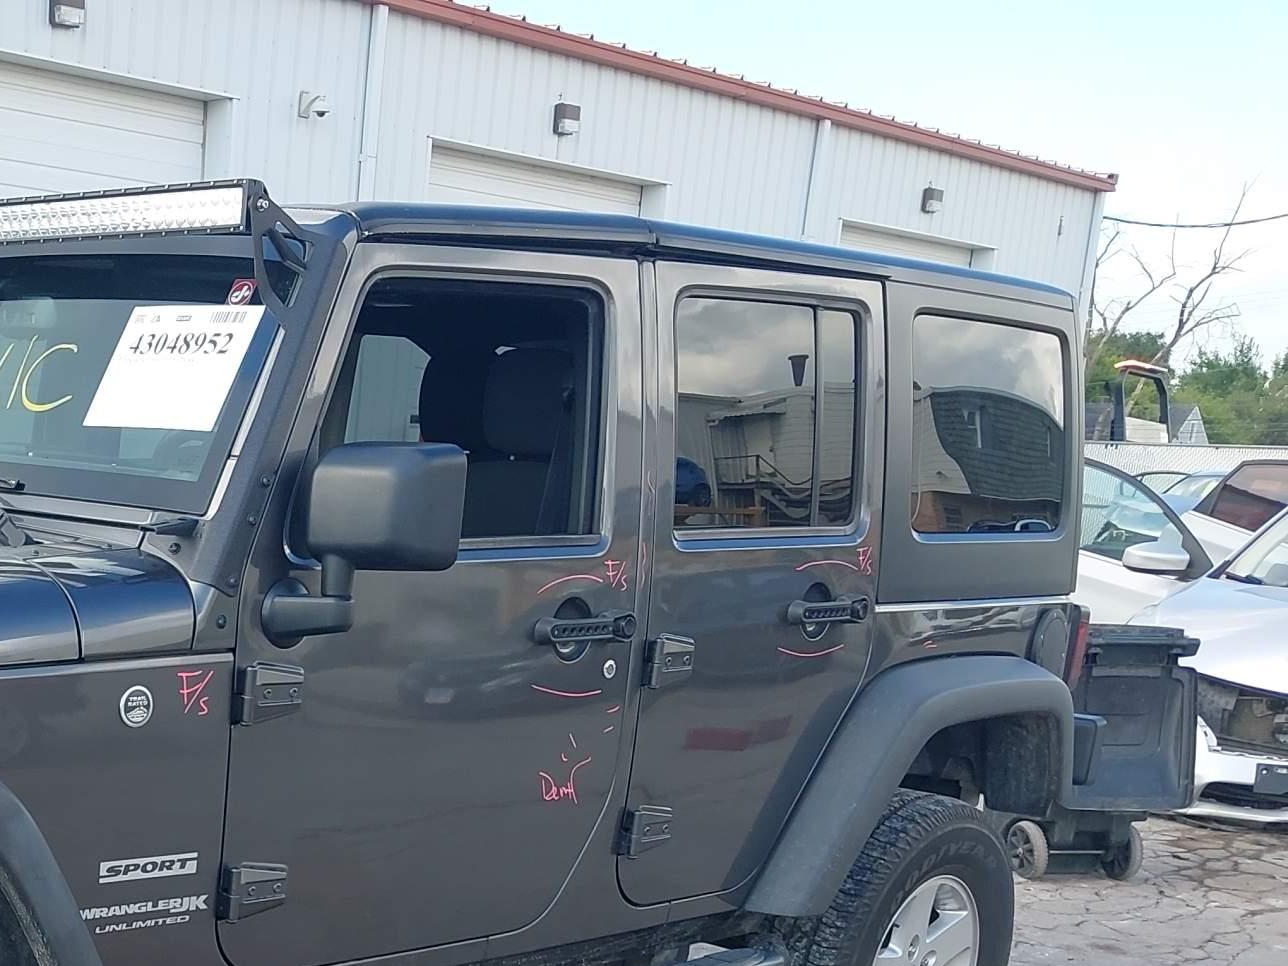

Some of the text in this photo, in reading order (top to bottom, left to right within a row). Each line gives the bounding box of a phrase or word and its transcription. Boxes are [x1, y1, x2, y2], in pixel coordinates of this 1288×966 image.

[129, 332, 234, 355] 43048952
[104, 859, 193, 878] SPORT
[95, 914, 191, 934] UNLIMITED
